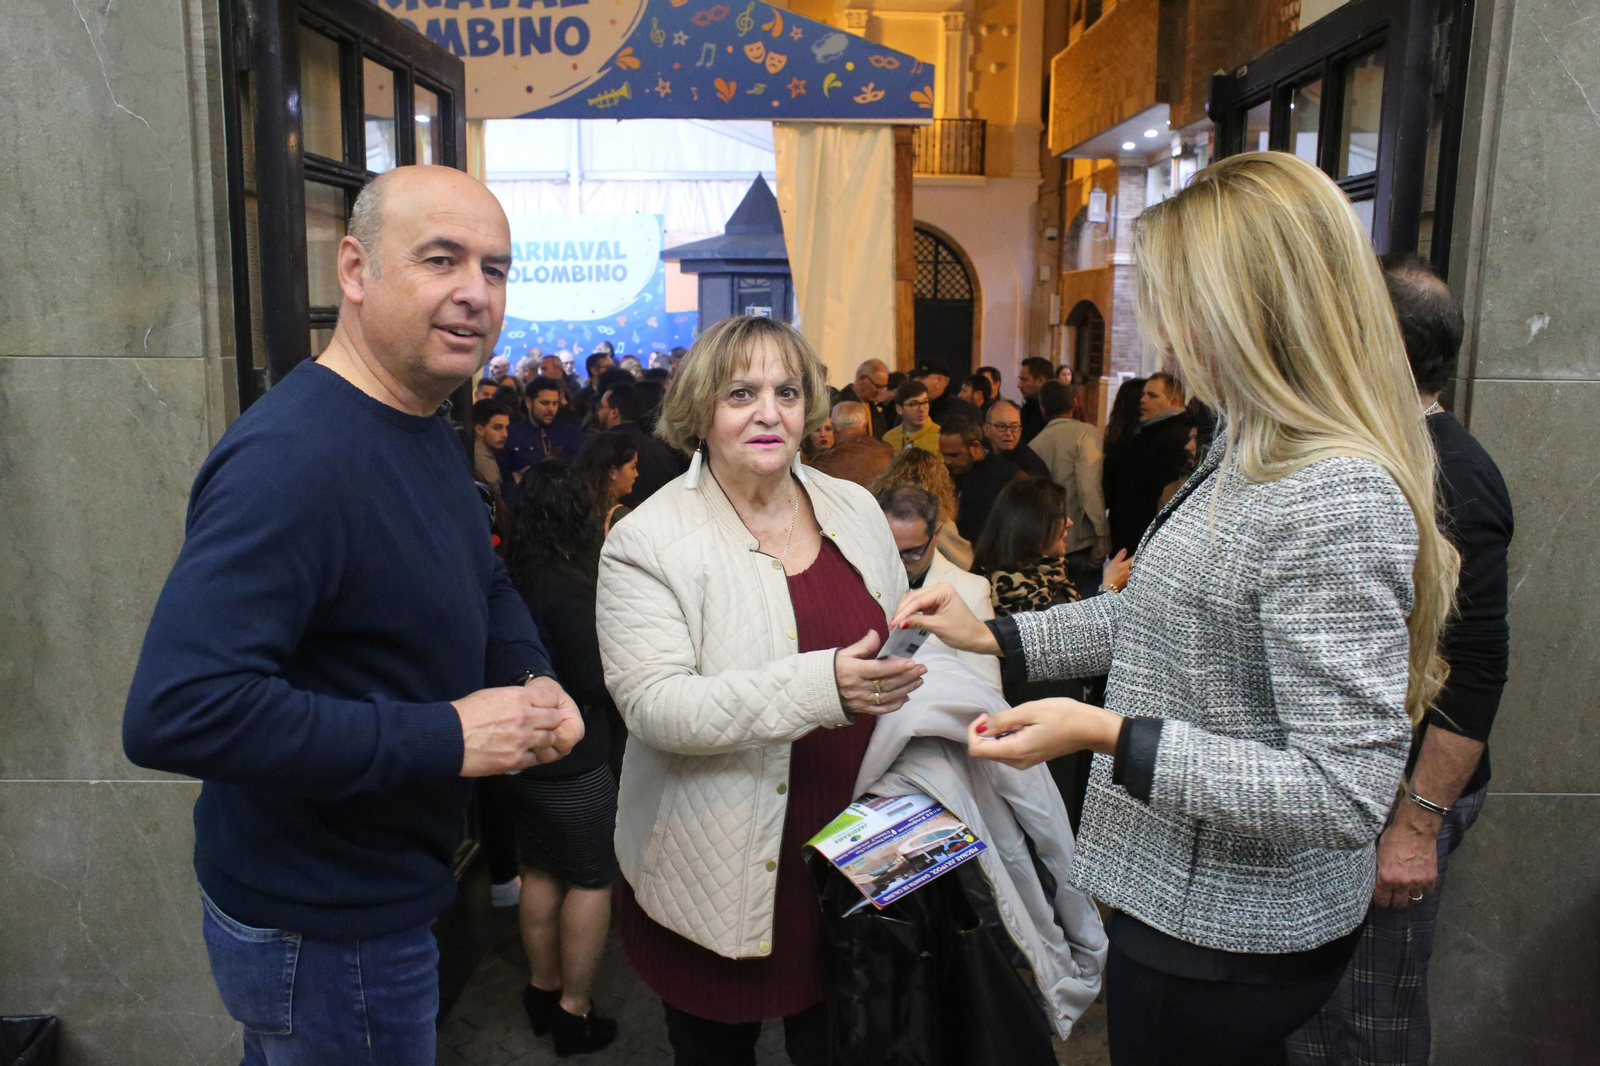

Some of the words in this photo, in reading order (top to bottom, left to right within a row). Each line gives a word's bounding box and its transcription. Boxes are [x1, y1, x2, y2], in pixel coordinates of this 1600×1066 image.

[396, 16, 590, 58] MBINO
[511, 241, 627, 262] ARNAVAL
[507, 264, 628, 284] OLOMBINO
[833, 822, 868, 845] JARDIRAMA
[955, 846, 979, 861] PISCINAS
[931, 859, 956, 875] JULYPOOL
